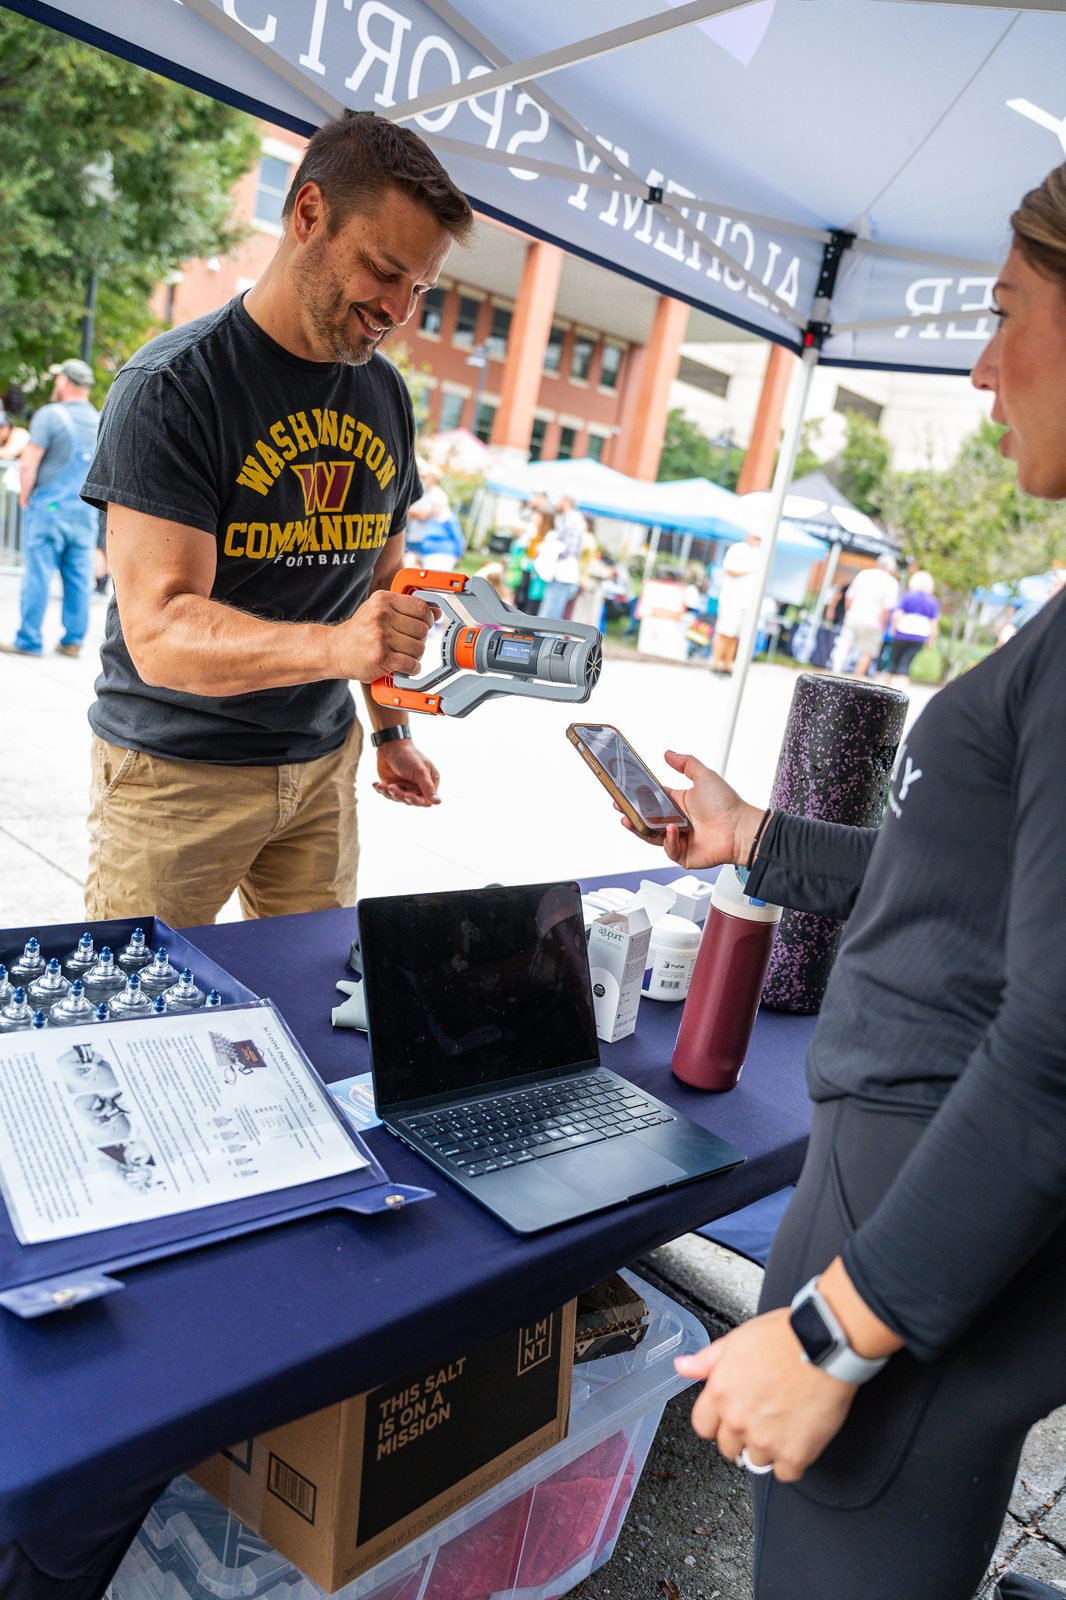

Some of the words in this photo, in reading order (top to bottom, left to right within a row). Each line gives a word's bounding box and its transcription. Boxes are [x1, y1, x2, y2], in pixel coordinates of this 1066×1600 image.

[235, 408, 397, 496] WASHINGTON
[273, 553, 356, 568] FOOTBALL
[524, 1337, 546, 1365] NT
[525, 1317, 547, 1345] LM
[379, 1383, 420, 1419] THIS
[424, 1356, 467, 1393] SALT
[376, 1402, 451, 1461] MISSION
[377, 1416, 396, 1440] IS
[400, 1399, 427, 1426] ON
[431, 1390, 444, 1410] A
